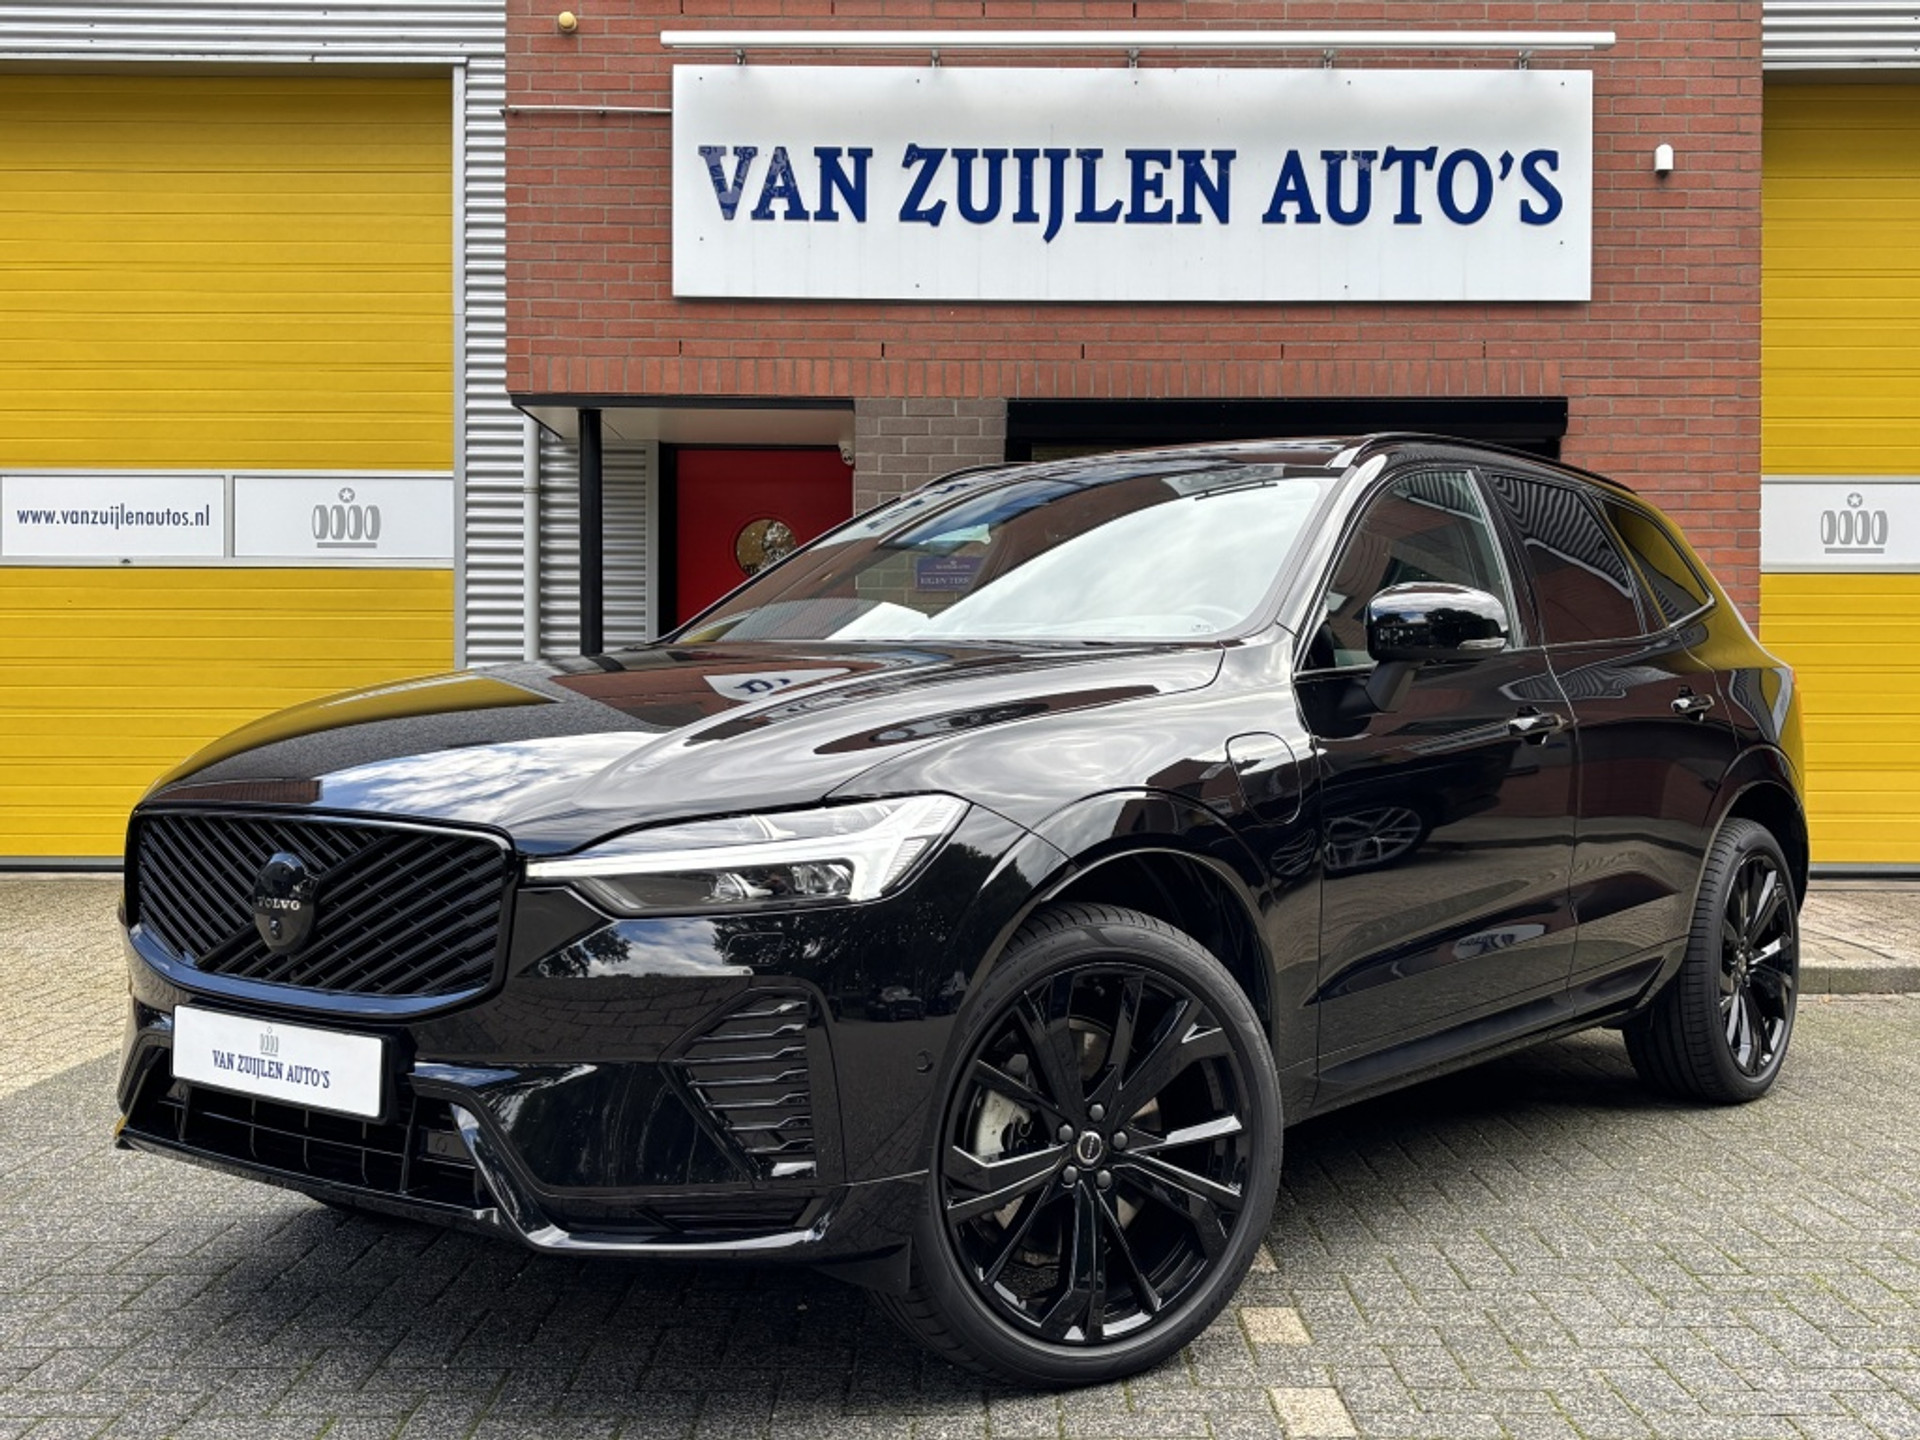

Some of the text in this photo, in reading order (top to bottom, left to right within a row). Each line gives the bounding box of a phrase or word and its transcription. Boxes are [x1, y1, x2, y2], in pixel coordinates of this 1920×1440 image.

[698, 143, 1563, 244] VAN ZUIJLEN AUTO'S
[17, 503, 210, 530] www.vanzuijlenautos.nl
[257, 896, 301, 911] VOLVO
[212, 1050, 330, 1089] VAN ZUIJLEN AUTO'S
